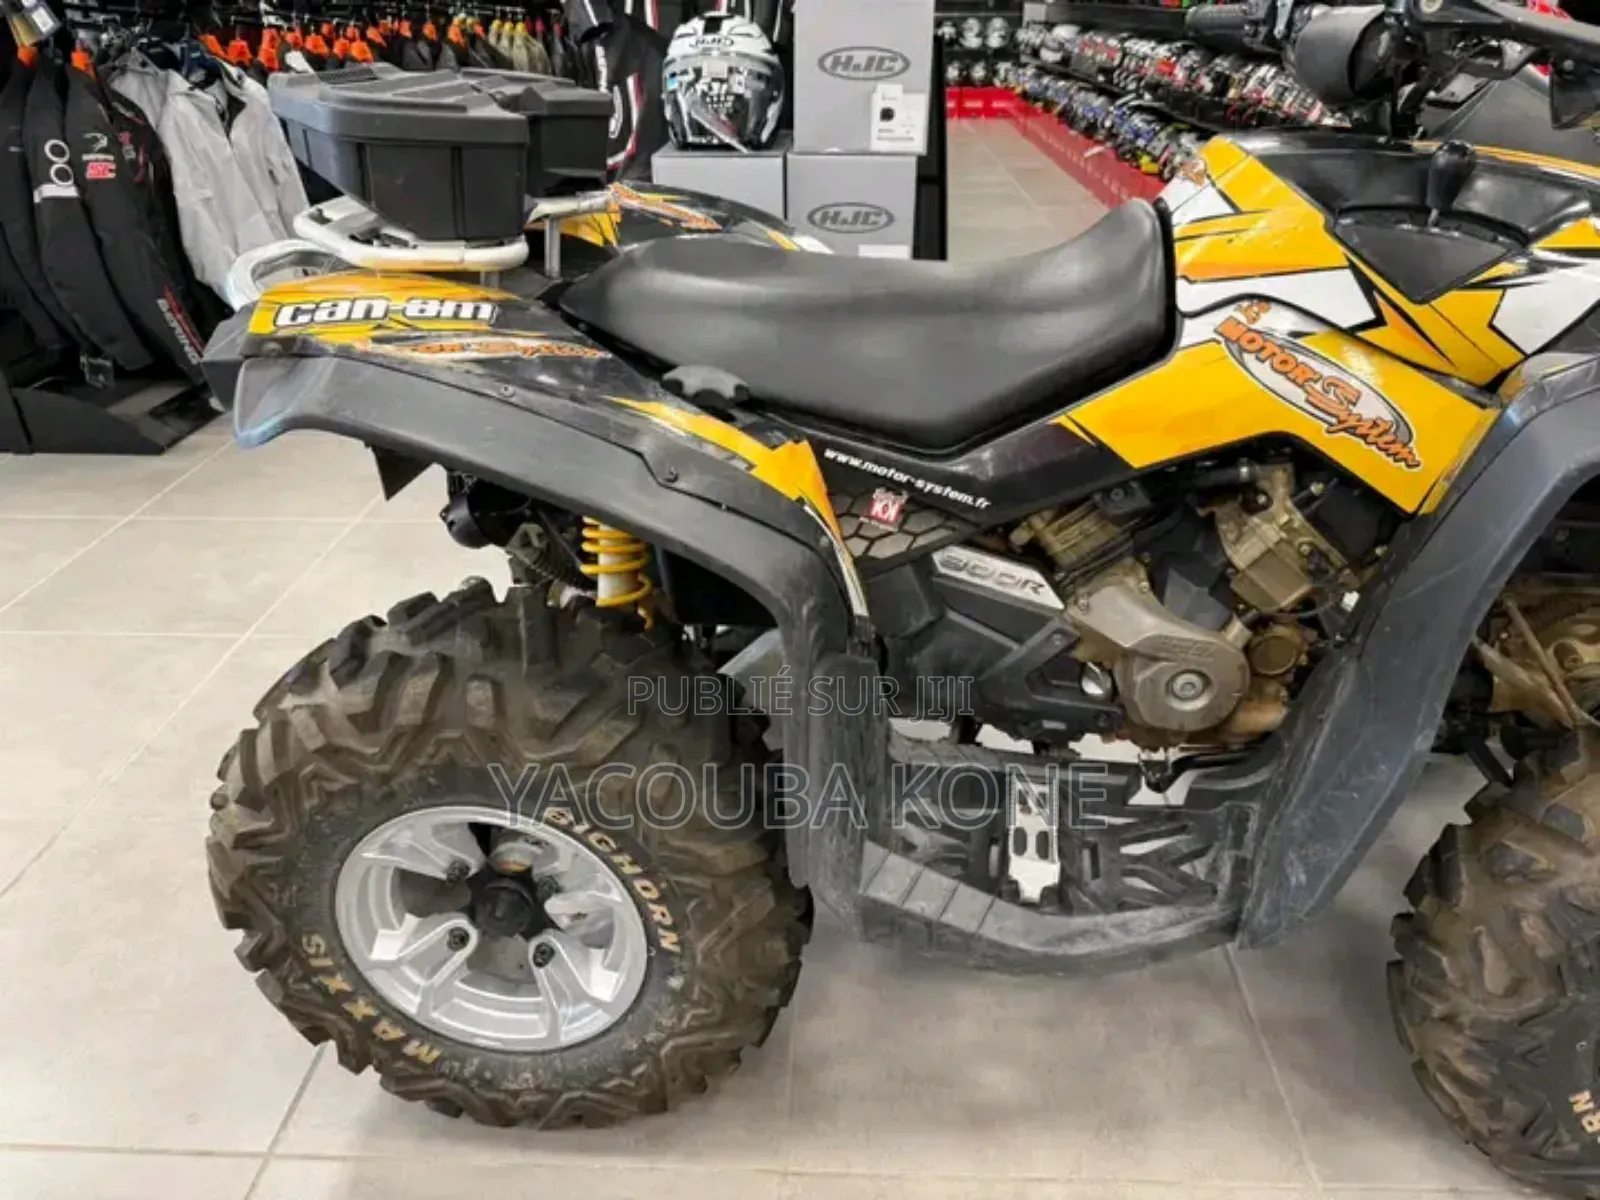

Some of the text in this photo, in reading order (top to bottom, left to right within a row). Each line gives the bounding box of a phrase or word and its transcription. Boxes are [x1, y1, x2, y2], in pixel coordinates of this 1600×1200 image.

[830, 55, 898, 72] HJC
[820, 211, 882, 225] HJC
[1214, 316, 1323, 388] MOTOR
[823, 447, 992, 510] www.motor-system.fr
[545, 806, 682, 954] BIGHORN
[302, 933, 441, 1065] MAXXIS
